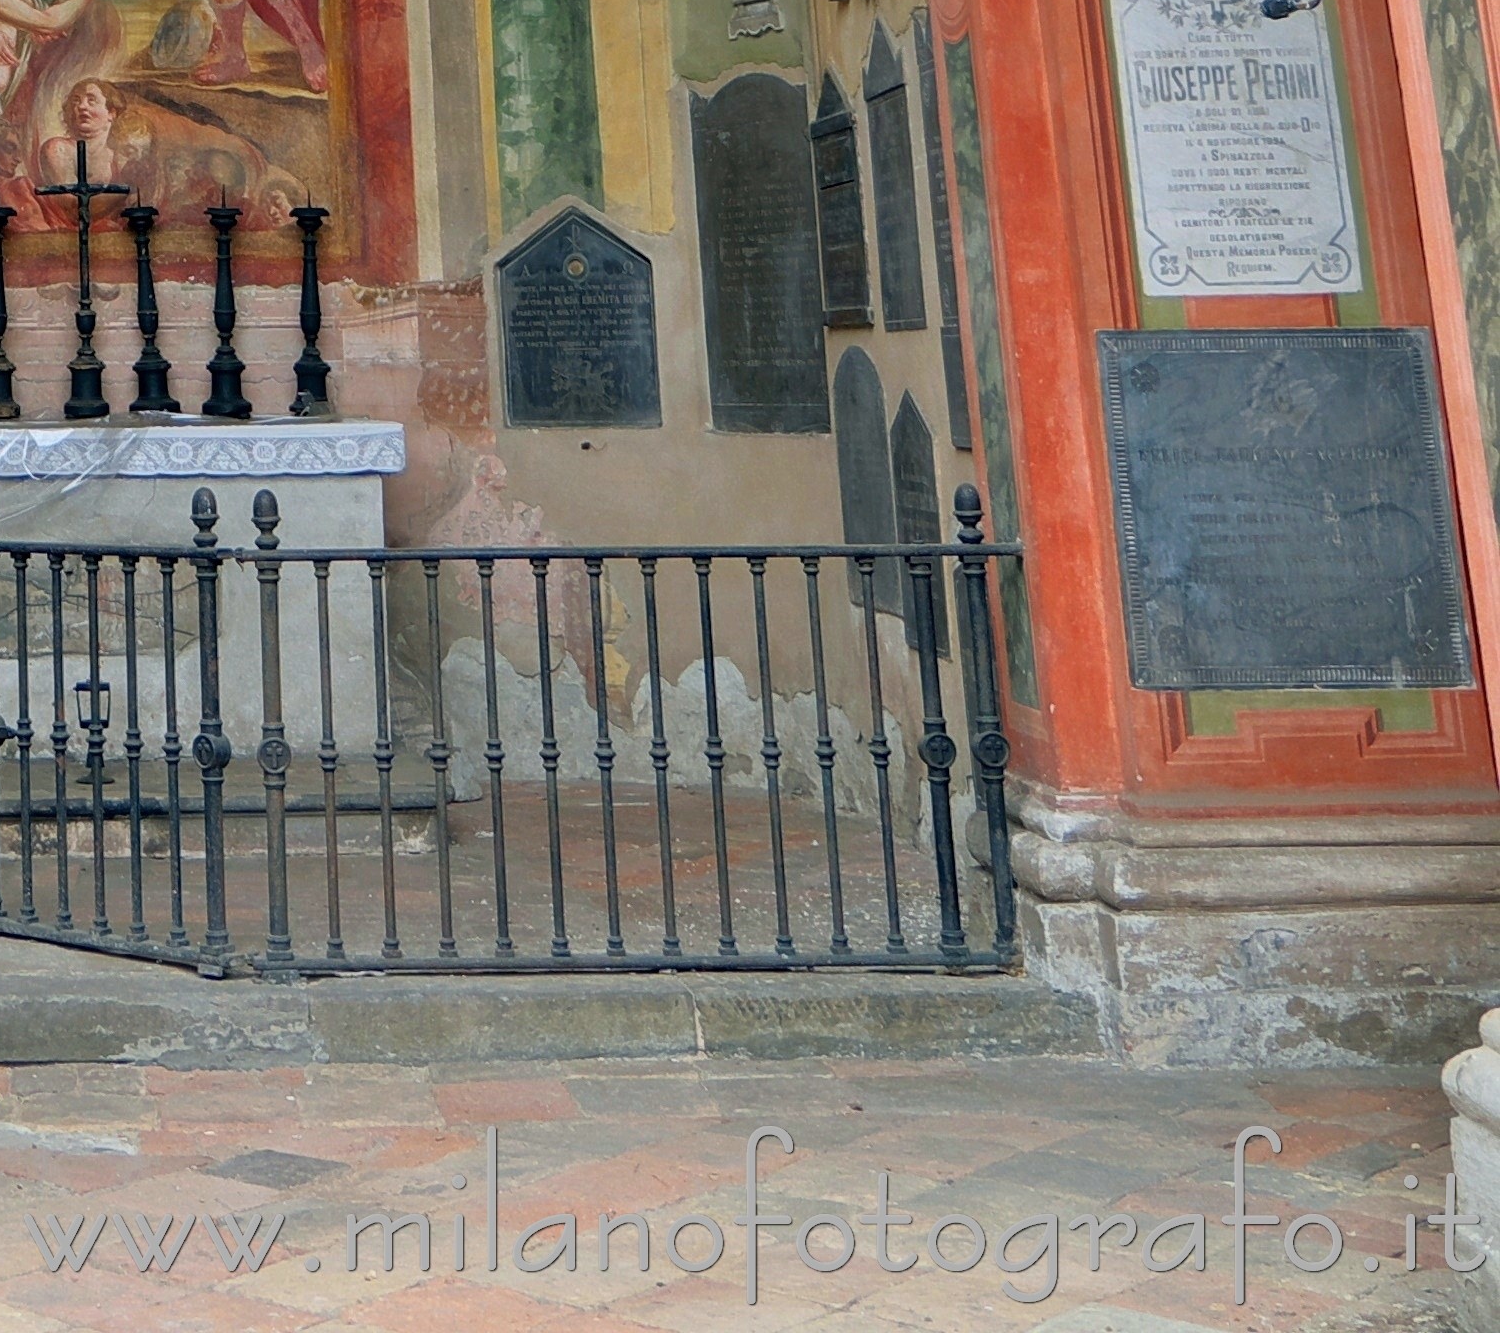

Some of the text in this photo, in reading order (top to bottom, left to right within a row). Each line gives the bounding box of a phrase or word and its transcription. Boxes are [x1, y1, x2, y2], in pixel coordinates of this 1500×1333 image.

[1225, 32, 1256, 43] TUTTI
[1132, 57, 1320, 109] GIUSEPPE PERINI
[1229, 182, 1241, 193] LA
[1186, 246, 1225, 259] QUESTA
[1228, 245, 1276, 258] MEMORIA
[520, 259, 634, 279] A Ω
